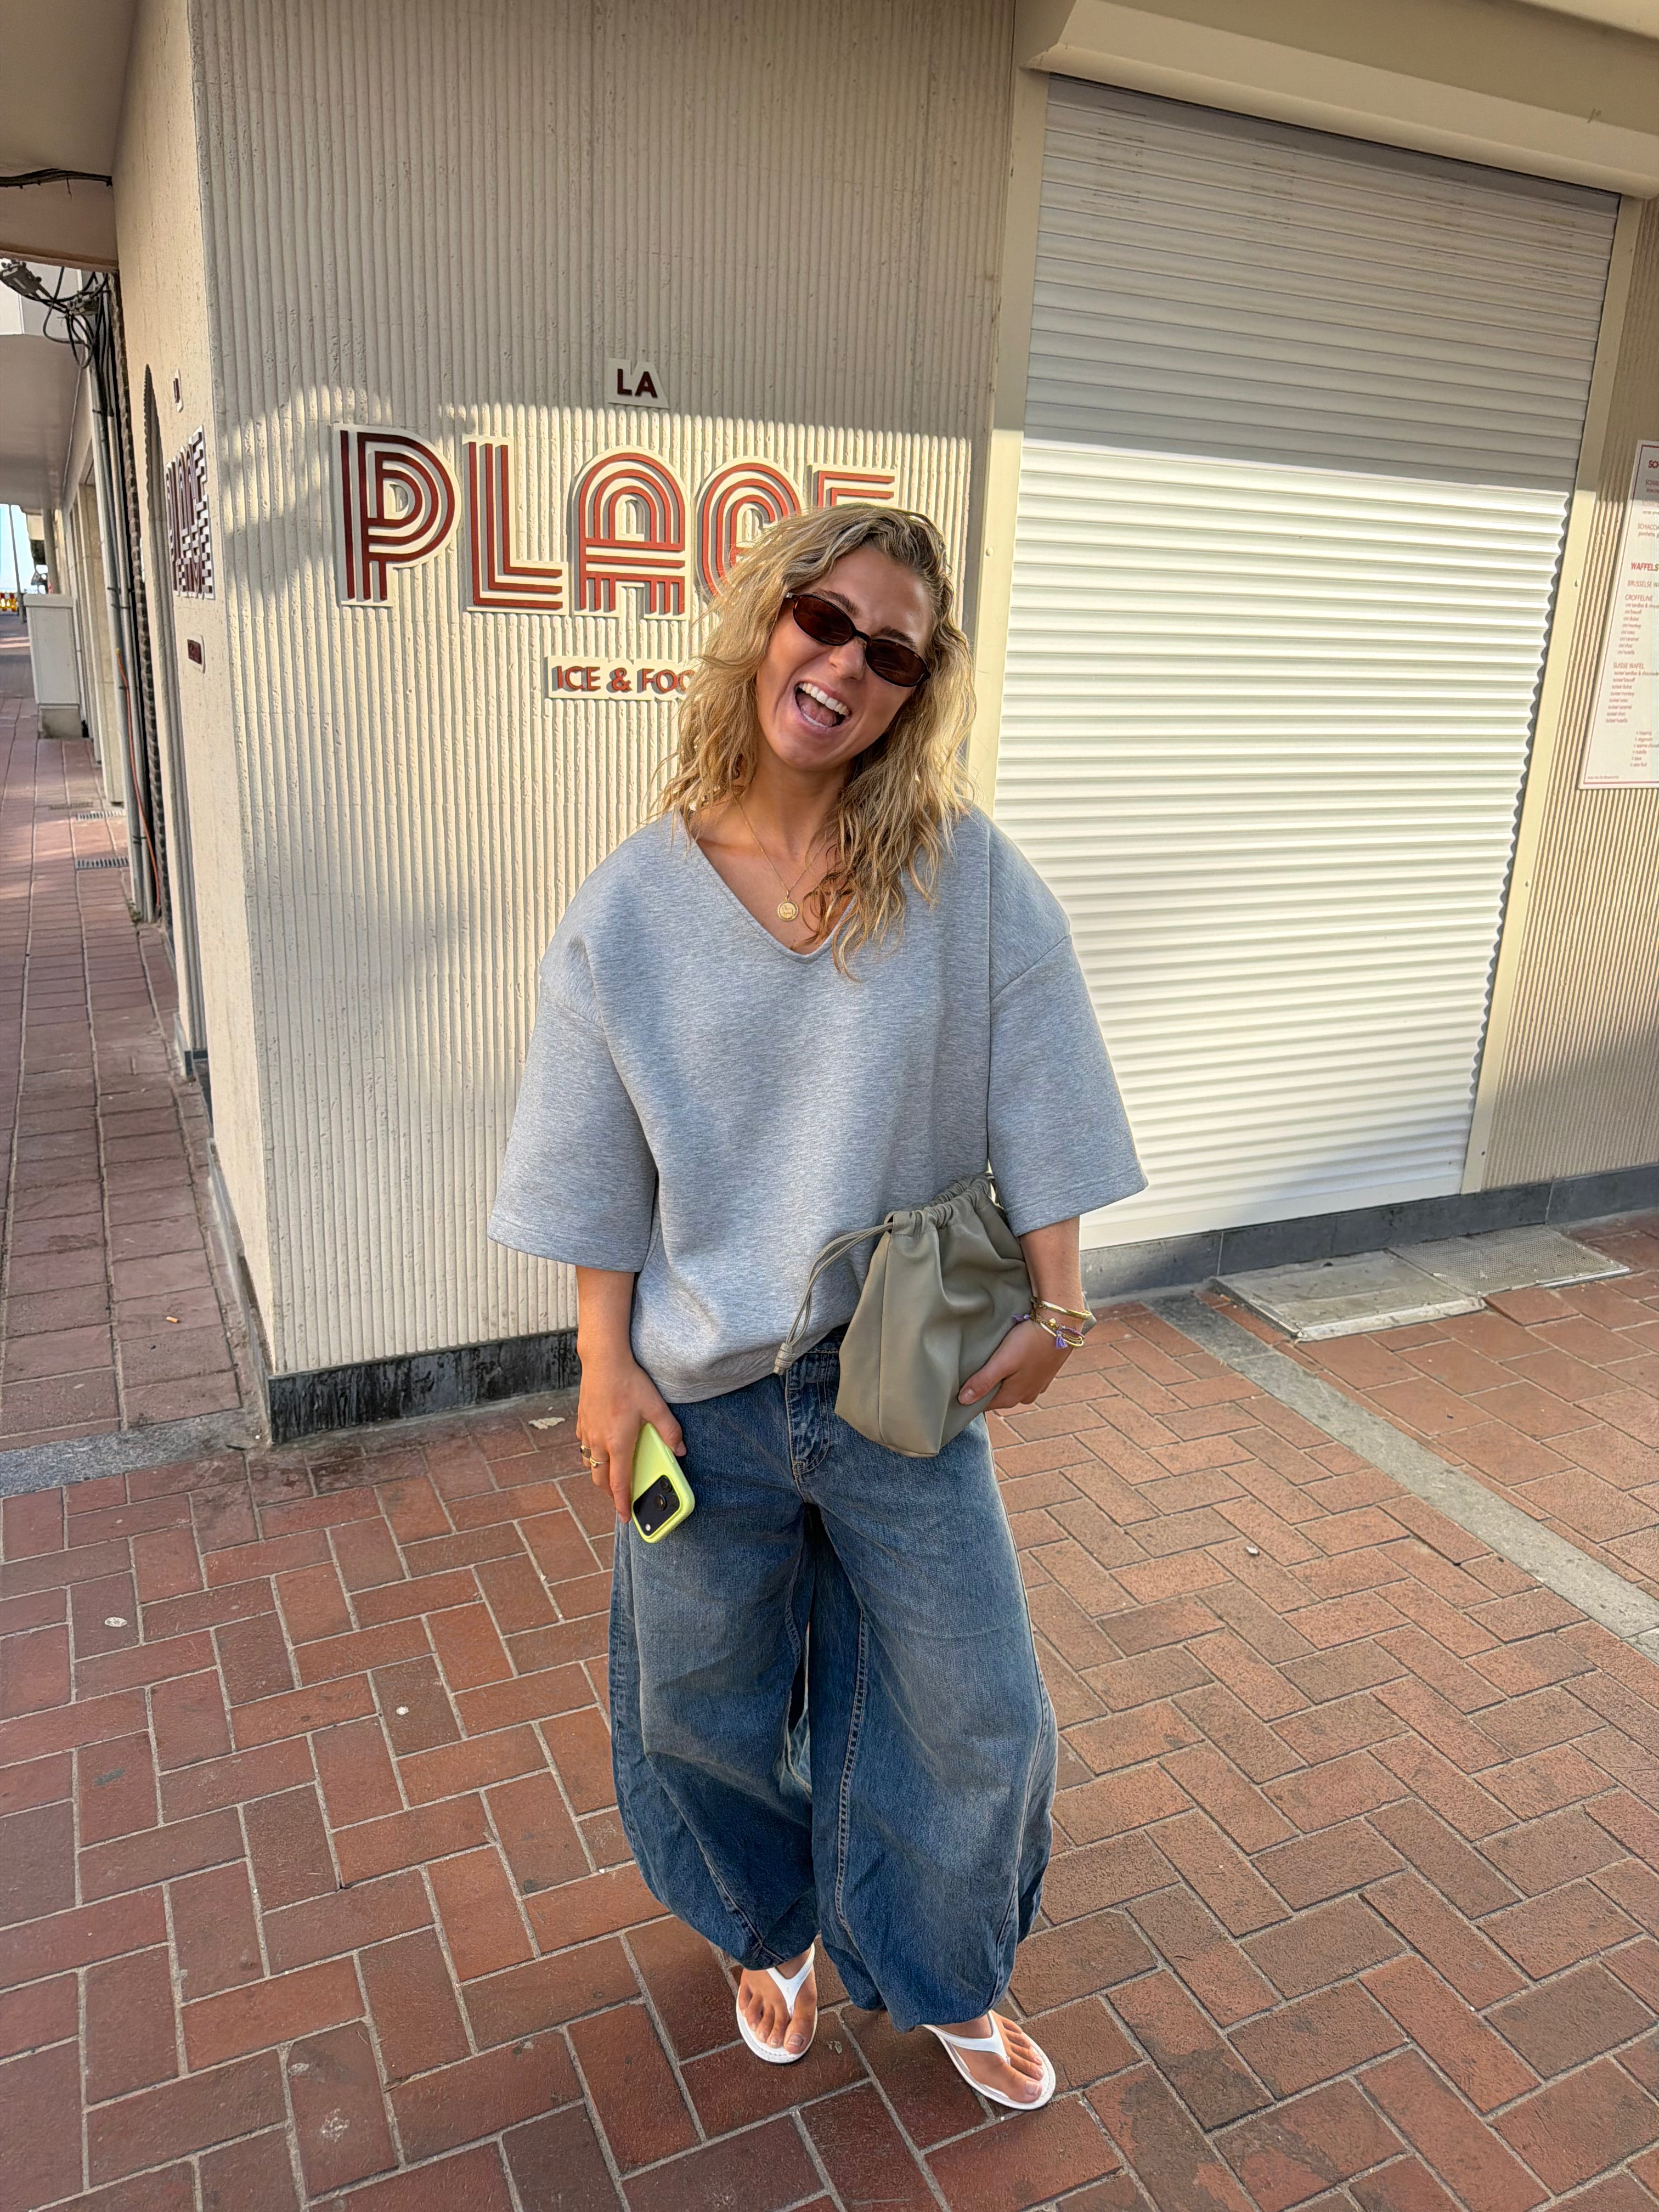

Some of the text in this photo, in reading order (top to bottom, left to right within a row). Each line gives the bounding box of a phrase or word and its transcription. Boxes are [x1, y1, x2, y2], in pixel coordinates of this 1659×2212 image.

[617, 368, 658, 398] LA
[340, 430, 895, 614] PLAG
[557, 665, 601, 691] ICE
[612, 667, 633, 691] &
